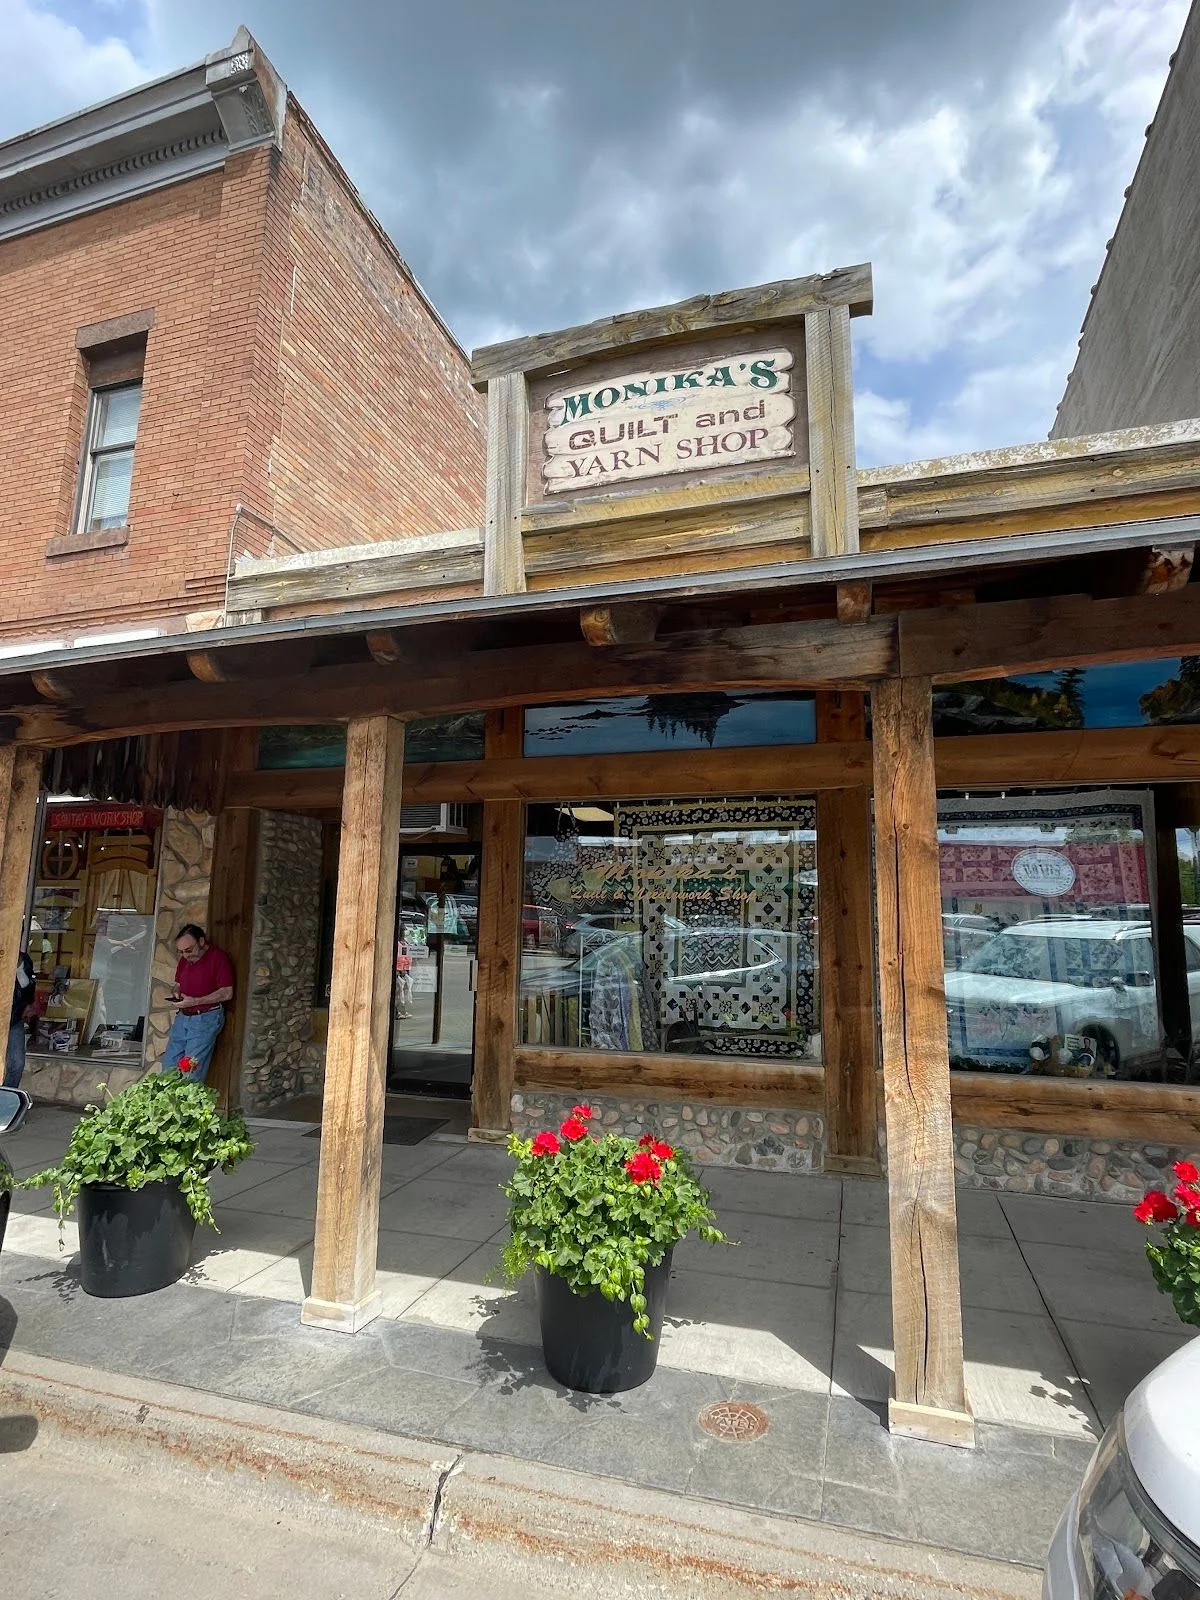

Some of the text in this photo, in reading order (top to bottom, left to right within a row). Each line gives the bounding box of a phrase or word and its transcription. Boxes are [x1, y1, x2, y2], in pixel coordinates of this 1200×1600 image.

[561, 358, 778, 425] MONIKA'S
[568, 400, 766, 450] QUILT and
[567, 428, 769, 478] YARN SHOP
[590, 862, 738, 881] Monkas
[715, 885, 757, 904] Shop
